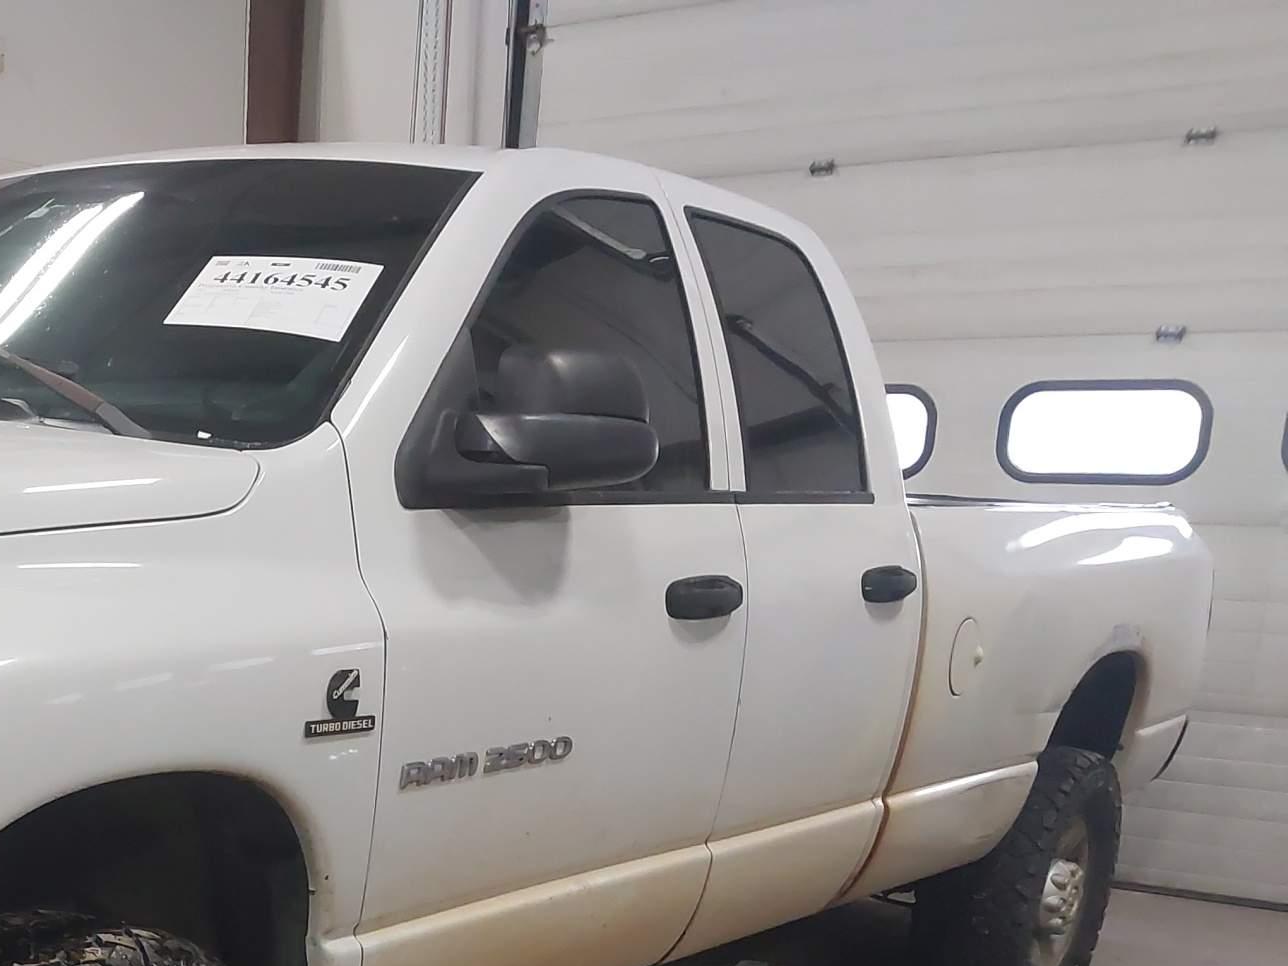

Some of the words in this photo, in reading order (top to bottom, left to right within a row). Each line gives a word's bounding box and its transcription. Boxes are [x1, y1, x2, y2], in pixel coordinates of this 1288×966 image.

[214, 271, 351, 292] 44164545
[310, 721, 341, 734] TURBO
[342, 718, 373, 731] DIESEL
[399, 752, 479, 790] RAM
[483, 736, 573, 773] 2500
